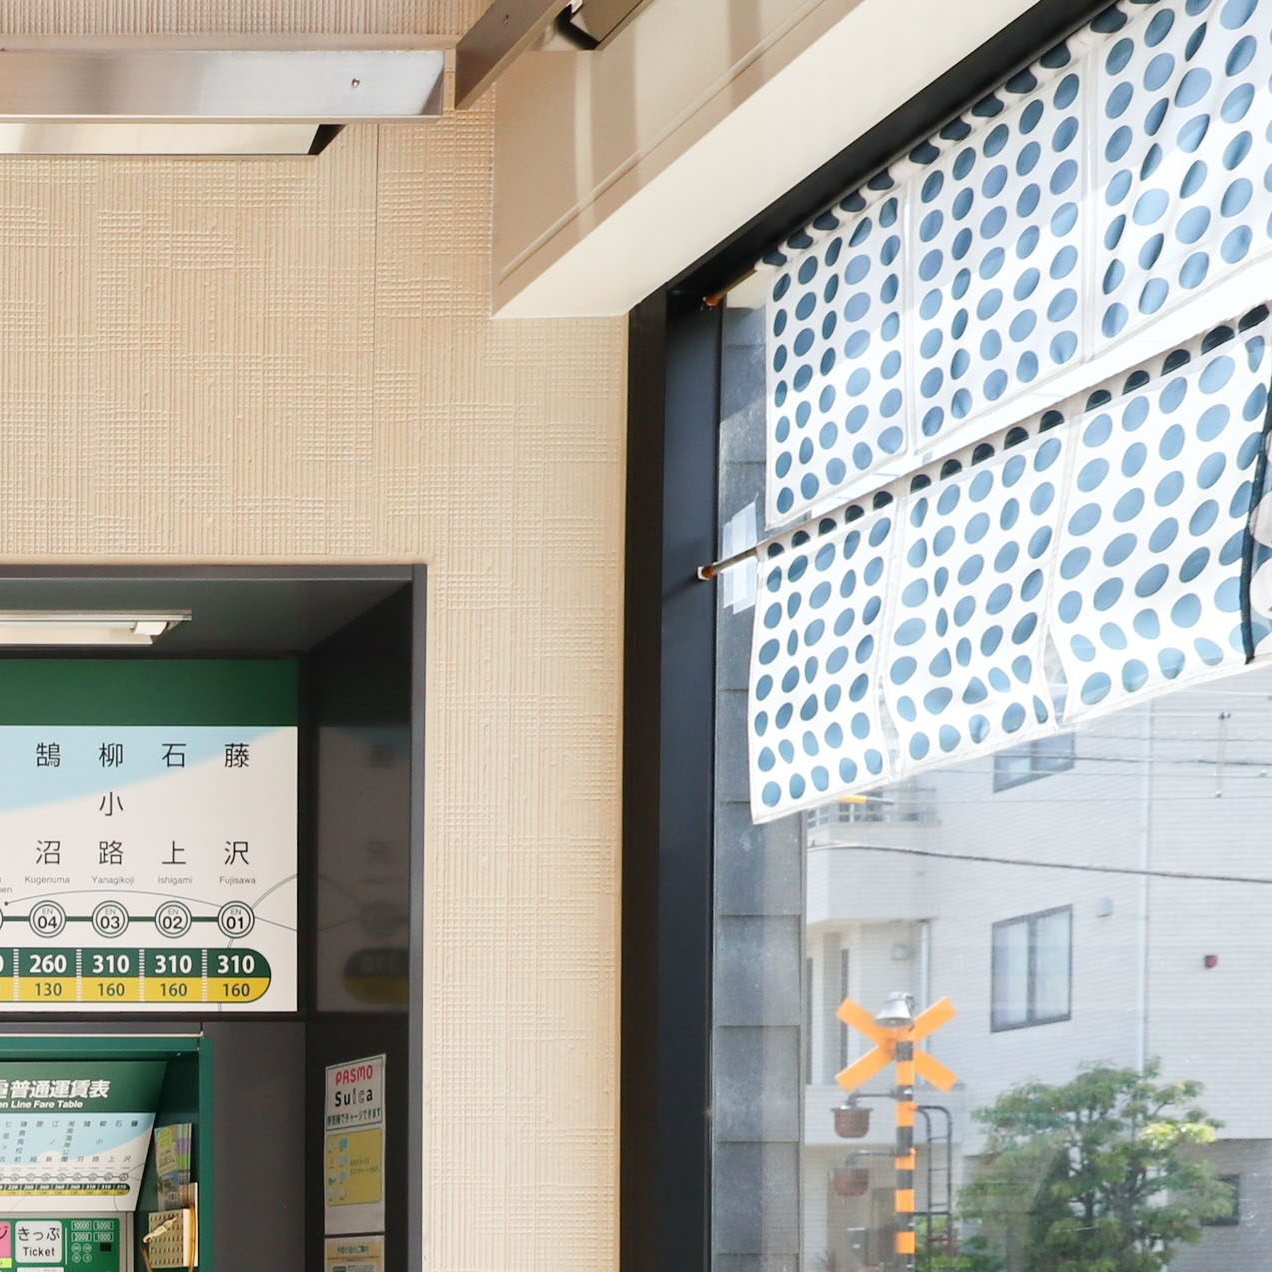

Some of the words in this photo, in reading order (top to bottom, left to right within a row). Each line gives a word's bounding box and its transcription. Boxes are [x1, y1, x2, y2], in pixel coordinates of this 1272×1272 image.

[36, 741, 61, 865] 鵠沼
[99, 741, 124, 865] 柳小路
[162, 741, 187, 865] 石上
[225, 741, 250, 865] 藤沢
[25, 876, 70, 885] Kugenuma
[92, 876, 134, 885] Yanagikoji
[158, 876, 192, 885] Ishigami
[219, 876, 256, 886] Fujisawa
[29, 954, 67, 974] 260
[92, 954, 130, 974] 310
[155, 954, 193, 974] 310
[217, 954, 255, 974] 310
[336, 1065, 373, 1085] PASMO
[11, 1100, 31, 1109] Line
[34, 1100, 54, 1109] Fare
[57, 1100, 83, 1109] Table
[335, 1088, 373, 1107] Suica
[18, 1227, 60, 1241] きっぷ
[23, 1247, 55, 1256] Ticket
